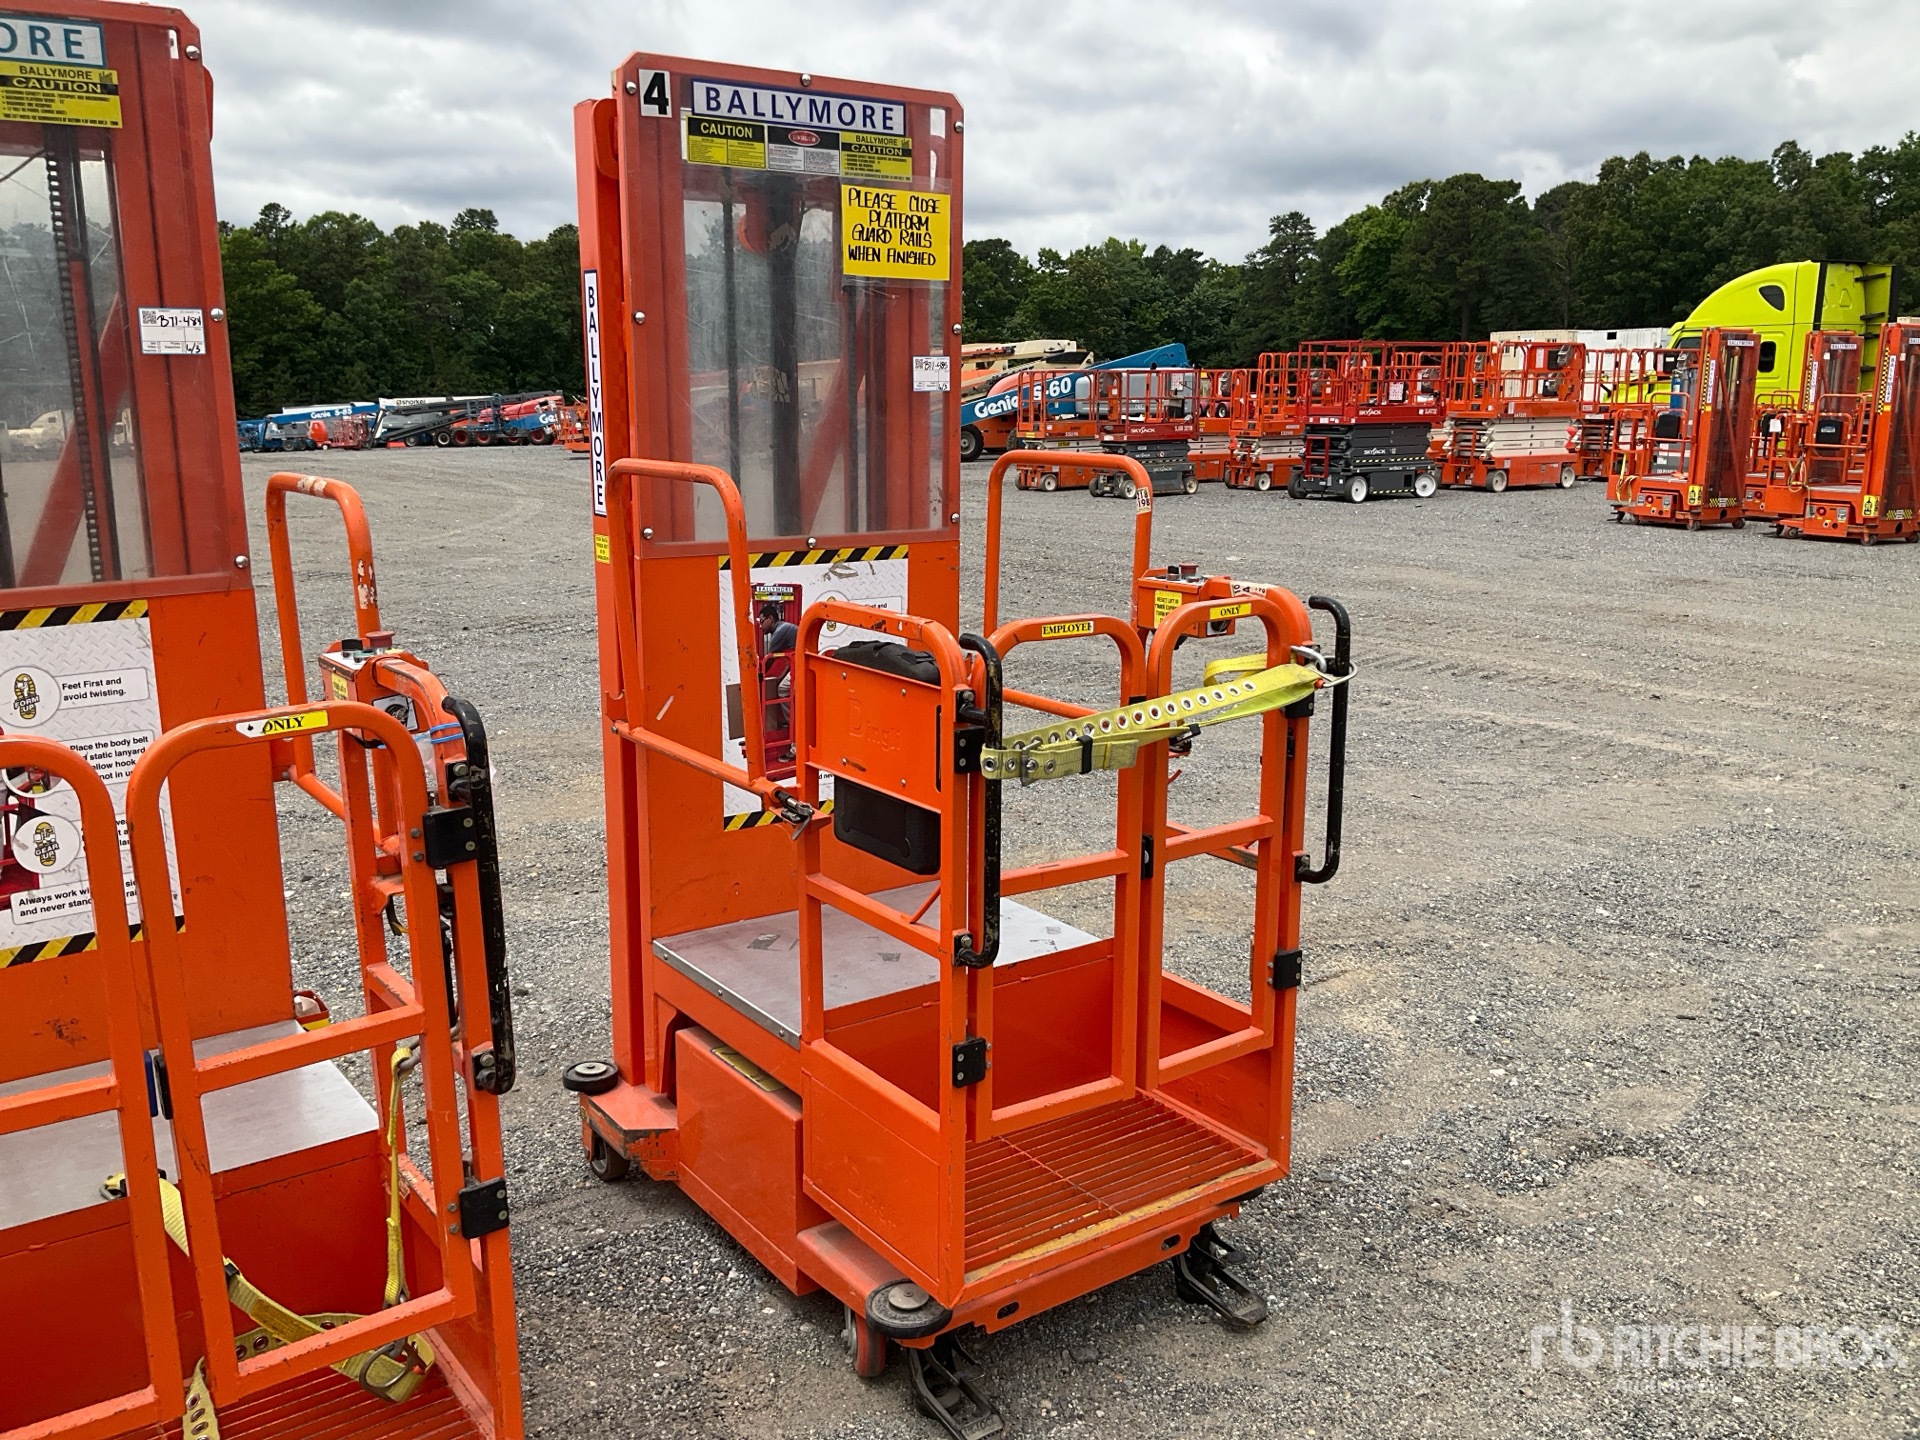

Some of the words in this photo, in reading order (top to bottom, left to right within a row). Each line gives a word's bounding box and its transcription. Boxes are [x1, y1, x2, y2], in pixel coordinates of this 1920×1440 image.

[19, 65, 93, 80] BALLYMORE
[13, 77, 102, 93] CAUTION
[643, 72, 670, 115] 4
[705, 86, 894, 131] BALLYMORE
[700, 122, 753, 139] CAUTION
[855, 134, 898, 146] BALLYMORE
[851, 144, 903, 156] CAUTION
[848, 187, 897, 210] PLEASE
[909, 195, 940, 214] CLOSE
[869, 209, 929, 231] PLATFORM
[852, 223, 892, 244] GUARD
[900, 228, 932, 248] RAILS
[848, 244, 881, 262] WHEN
[886, 248, 937, 266] FINISHED
[588, 286, 603, 506] BALLYMORE
[310, 410, 332, 419] Genie
[1359, 408, 1381, 416] SKYJACK
[1364, 447, 1385, 455] SKYJACK
[1220, 605, 1241, 617] ONLY
[61, 681, 81, 690] Feet
[83, 679, 104, 688] First
[105, 676, 122, 685] and
[63, 690, 88, 701] avoid
[89, 688, 127, 698] twisting.
[13, 695, 40, 710] FORM
[261, 716, 305, 734] ONLY
[70, 741, 93, 751] Place
[95, 740, 109, 749] the
[110, 737, 131, 747] body
[132, 735, 149, 744] belt
[89, 751, 113, 761] static
[115, 746, 146, 758] lanyard
[115, 758, 136, 767] hook
[99, 772, 113, 780] not
[115, 770, 123, 778] in
[18, 894, 53, 907] Always
[54, 887, 78, 900] work
[20, 905, 38, 917] and
[40, 902, 66, 913] never
